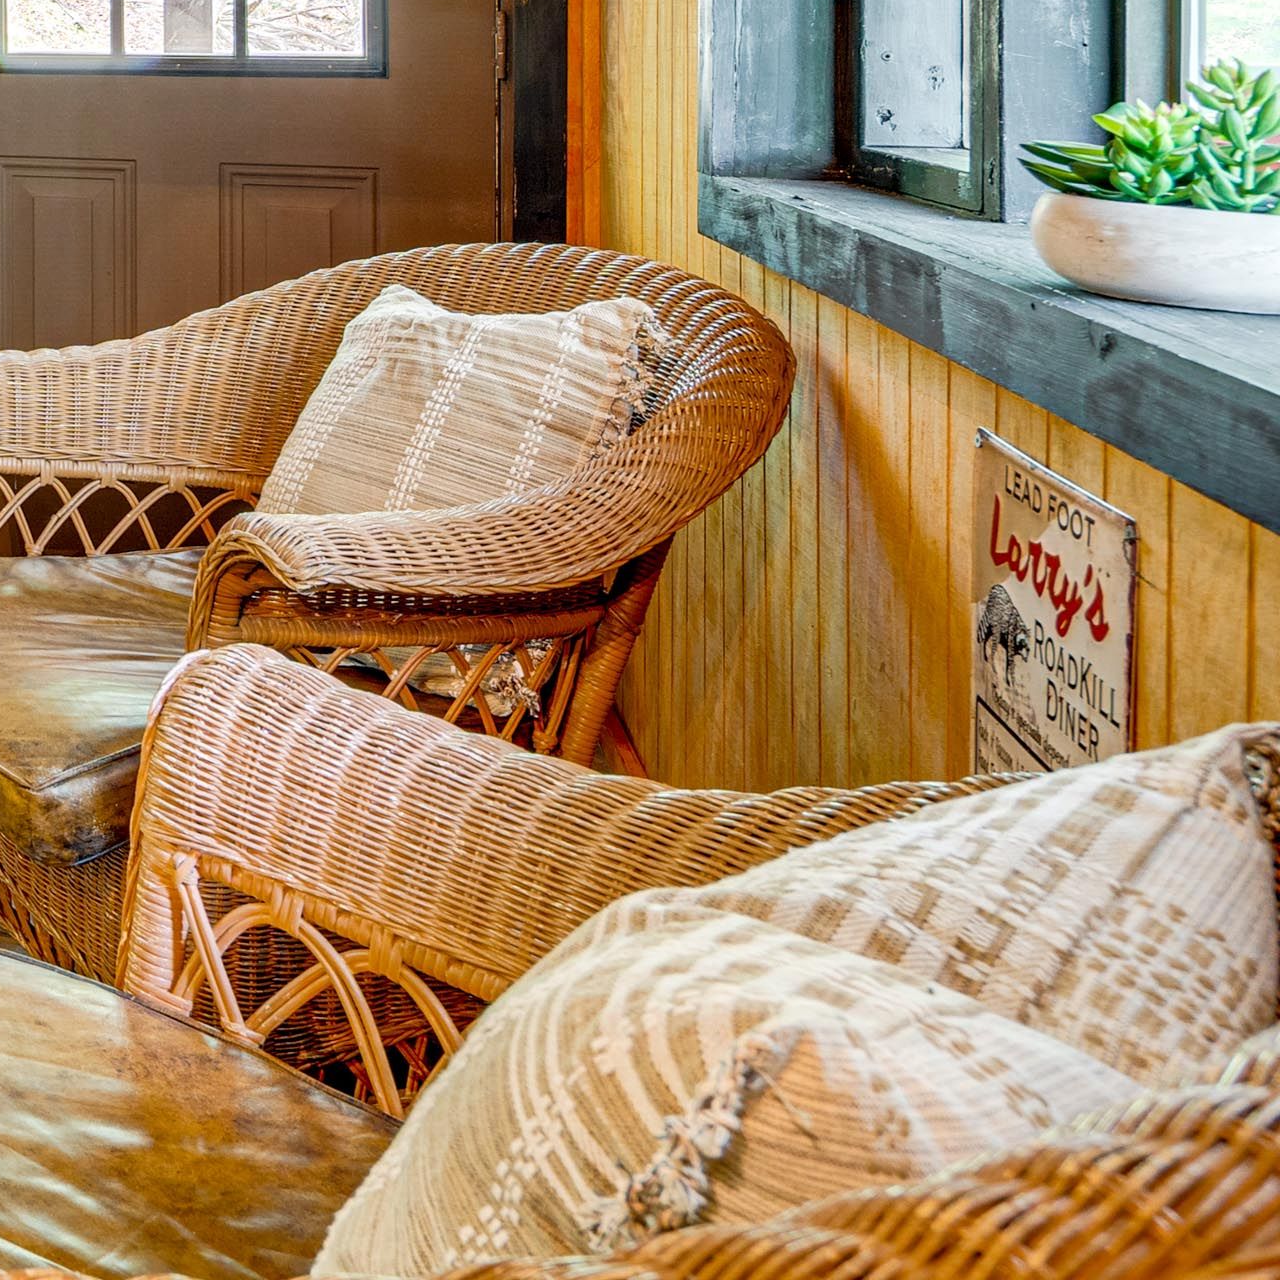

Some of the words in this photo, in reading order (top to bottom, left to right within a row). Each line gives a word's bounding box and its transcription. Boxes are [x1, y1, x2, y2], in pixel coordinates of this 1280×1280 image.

[1004, 464, 1042, 514] LEAD
[1046, 494, 1096, 548] FOOT
[990, 493, 1110, 643] Larry's
[1033, 619, 1121, 729] ROADKILL
[1046, 678, 1099, 762] DINER
